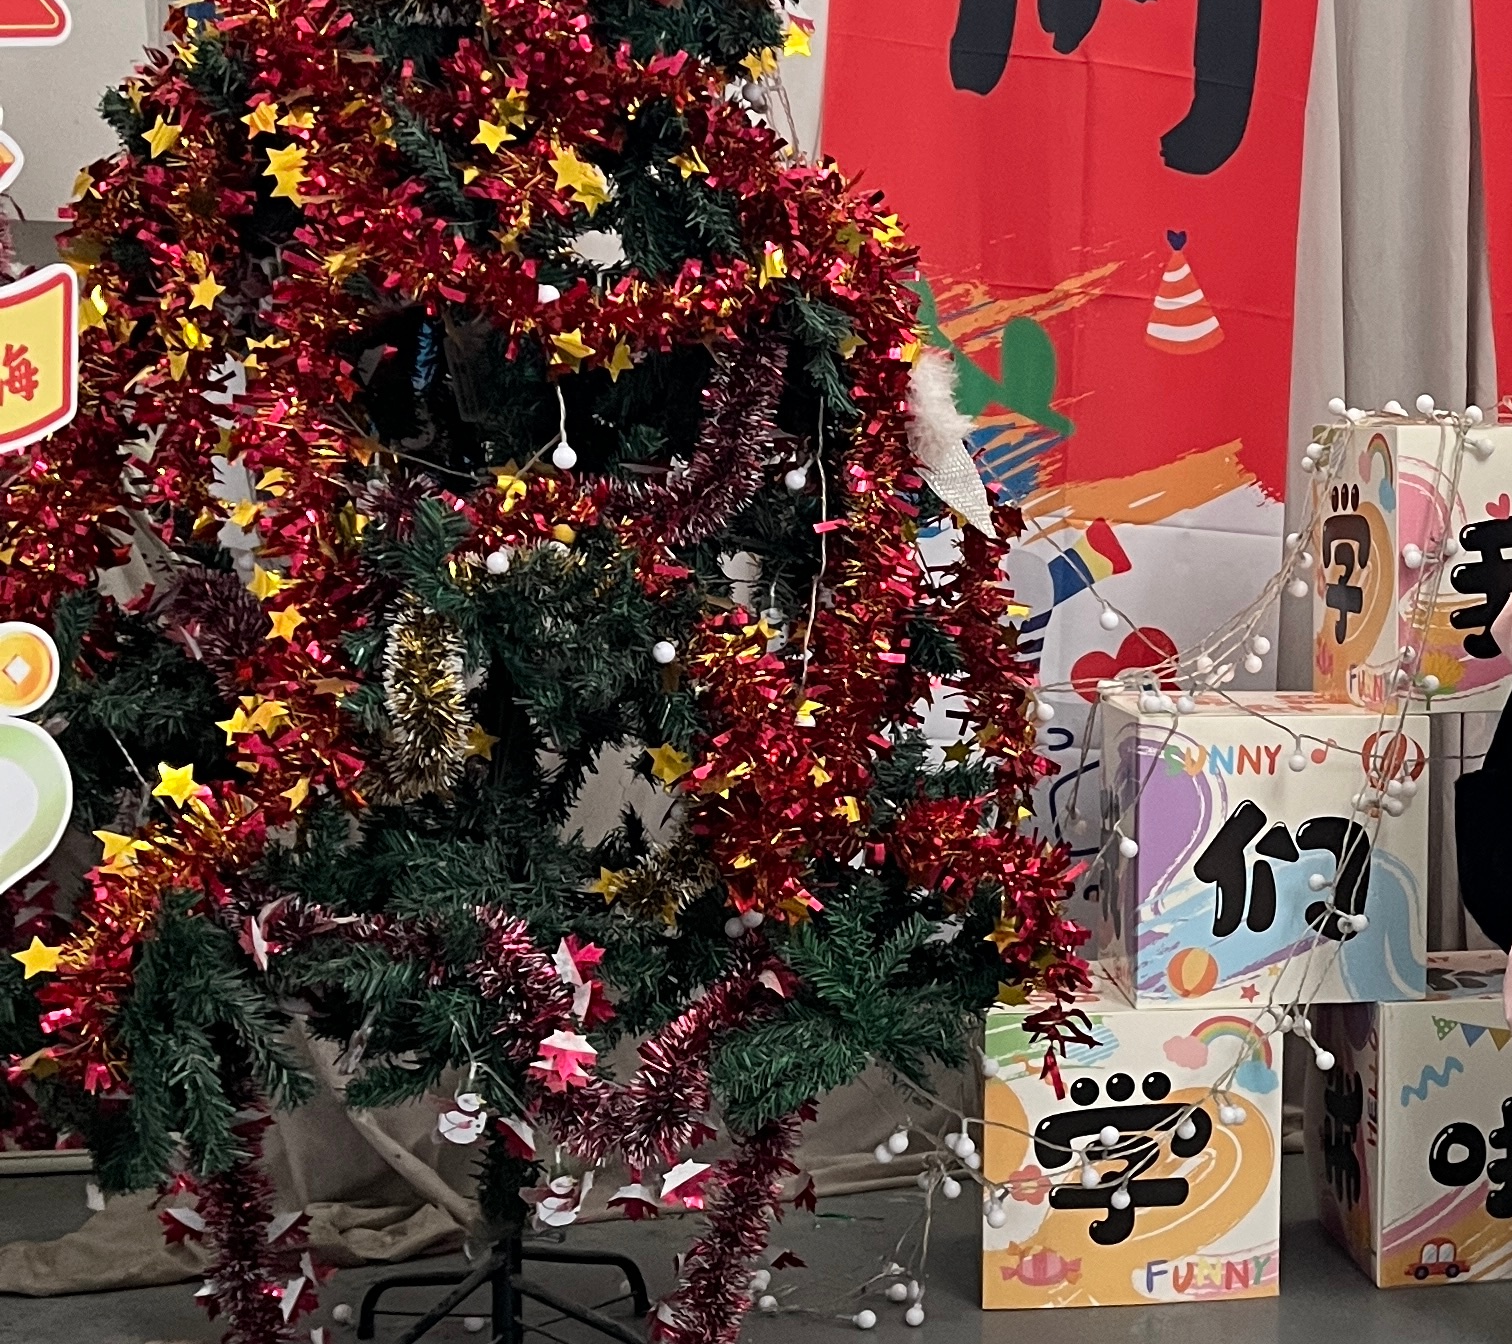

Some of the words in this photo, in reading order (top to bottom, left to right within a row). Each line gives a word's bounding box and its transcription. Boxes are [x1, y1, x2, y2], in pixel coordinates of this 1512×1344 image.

[1321, 482, 1372, 645] 学
[1164, 743, 1282, 777] SUNNY
[1193, 798, 1372, 942] 们
[1033, 1070, 1213, 1246] 学
[1145, 1255, 1271, 1294] FUNNY
